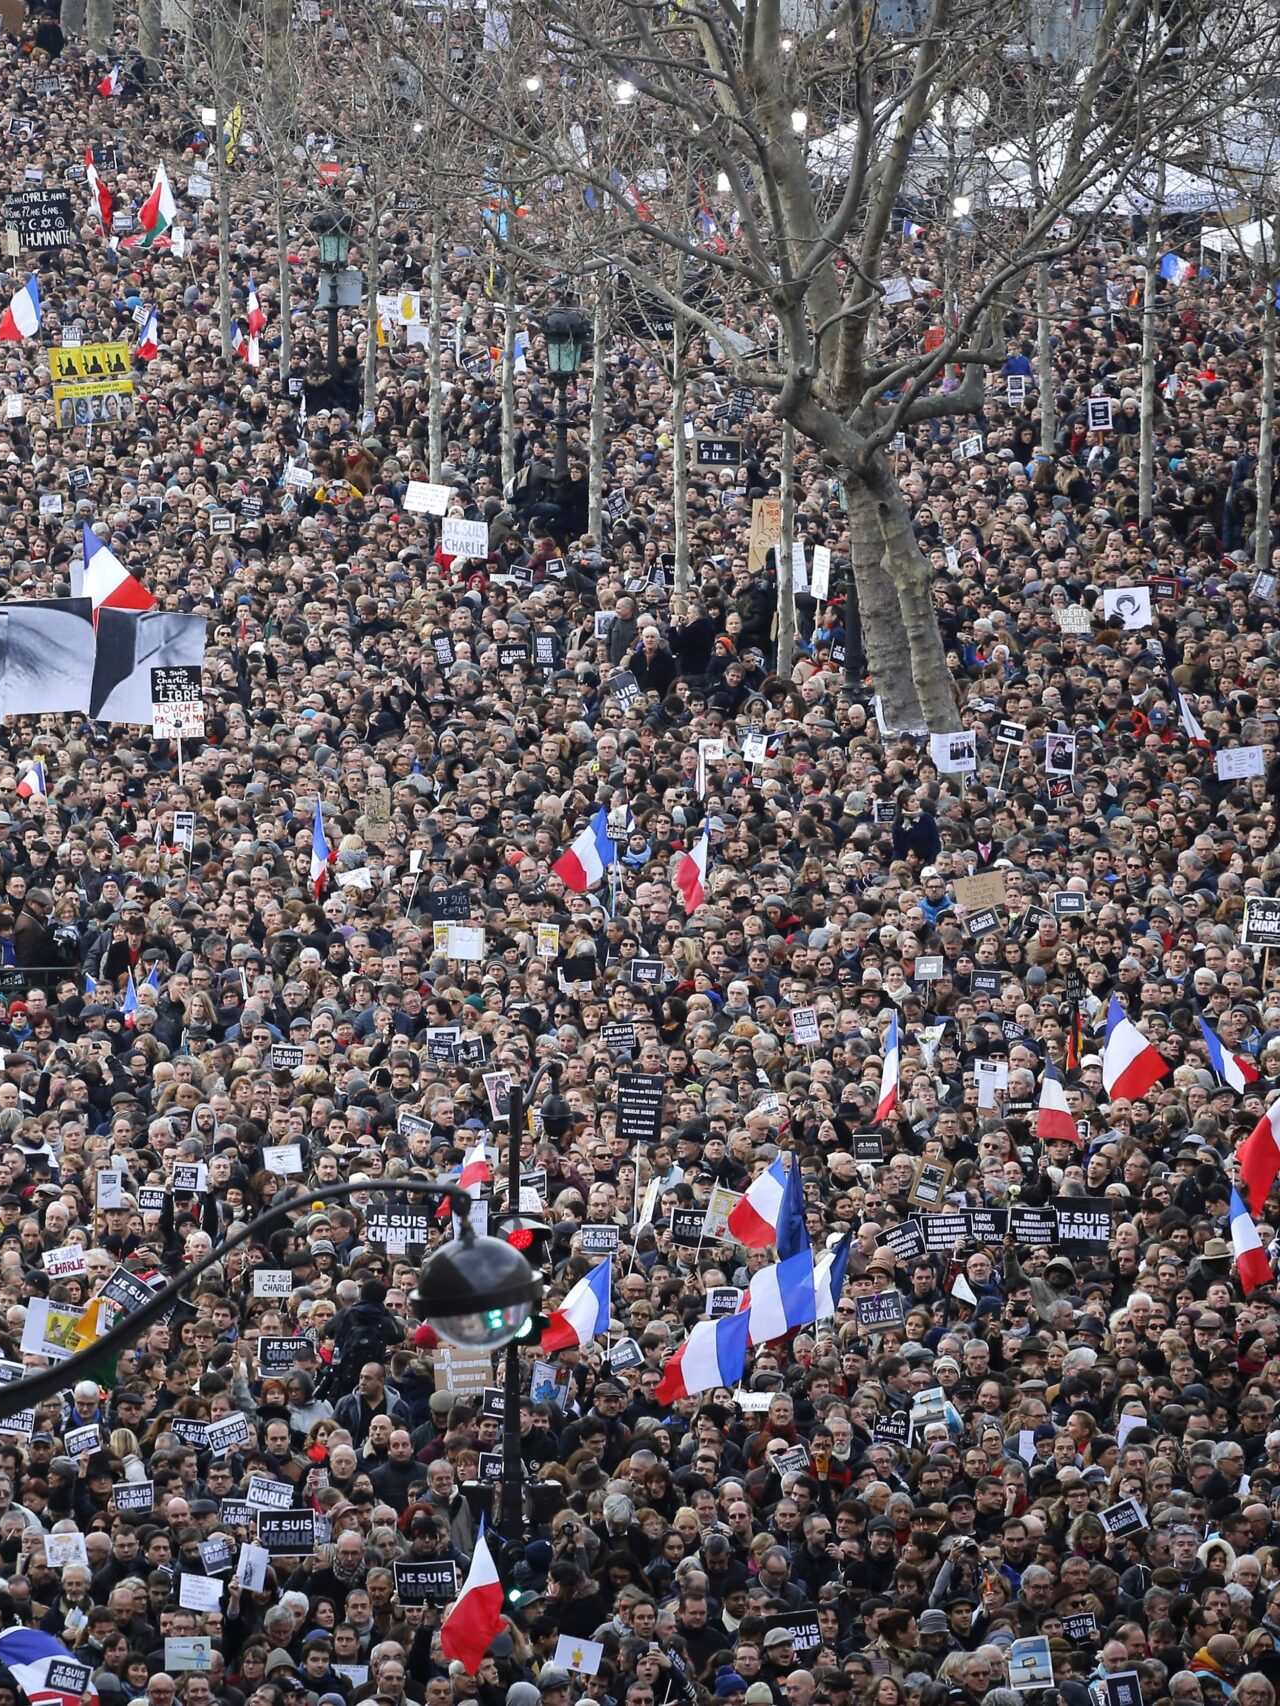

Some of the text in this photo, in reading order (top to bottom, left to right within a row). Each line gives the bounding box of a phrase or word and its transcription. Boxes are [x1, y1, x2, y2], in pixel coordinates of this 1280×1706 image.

[447, 522, 486, 538] JE SUIS
[445, 540, 486, 556] CHARLIE
[435, 638, 450, 647] NOUS
[537, 637, 552, 645] NOUS
[437, 650, 452, 659] TOUS
[510, 649, 527, 657] SUIS
[537, 650, 553, 658] TOUS
[159, 690, 200, 701] LIBRE
[154, 703, 200, 714] TOUCHE
[154, 716, 169, 725] PAS
[192, 714, 204, 723] MA
[161, 725, 204, 738] LIBERTÉ
[970, 912, 993, 928] JE SUIS
[971, 918, 996, 933] CHARLIE
[604, 1027, 633, 1036] JE SUIS
[274, 1056, 303, 1065] CHARLIE
[367, 1214, 428, 1228] JE SUIS
[974, 1213, 992, 1222] GABON
[978, 1223, 996, 1231] BONGO
[367, 1227, 428, 1244] CHARLIE
[596, 1231, 617, 1239] SUIS
[886, 1230, 902, 1241] GABON
[984, 1234, 1003, 1242] CHARLIE
[583, 1239, 618, 1248] CHARLIE
[48, 1246, 79, 1263] JE SUIS
[49, 1258, 86, 1276] CHARLIE
[266, 1274, 292, 1283] JE SUIS
[262, 1283, 292, 1292] CHARLIE
[862, 1308, 901, 1324] CHARLIE
[267, 1341, 308, 1350] JE SUIS
[173, 1423, 209, 1434] JE SUIS
[210, 1420, 245, 1440] JE SUIS
[876, 1424, 907, 1436] CHARLIE
[69, 1431, 95, 1445] JE SUIS
[212, 1429, 247, 1448] CHARLIE
[69, 1437, 97, 1454] CHARLIE
[786, 1458, 809, 1472] liberté
[116, 1488, 152, 1500] JE SUIS
[250, 1488, 292, 1507] CHARLIE
[117, 1496, 152, 1510] CHARLIE
[1109, 1508, 1136, 1526] JE SUIS
[1111, 1514, 1139, 1532] CHARLIE
[261, 1519, 313, 1531] JE SUIS
[261, 1531, 314, 1546] CHARLIE
[205, 1551, 230, 1565] CHARLIE
[399, 1571, 452, 1584] JE SUIS
[53, 1665, 87, 1679] JE SUIS
[50, 1674, 85, 1690] CHARLIE
